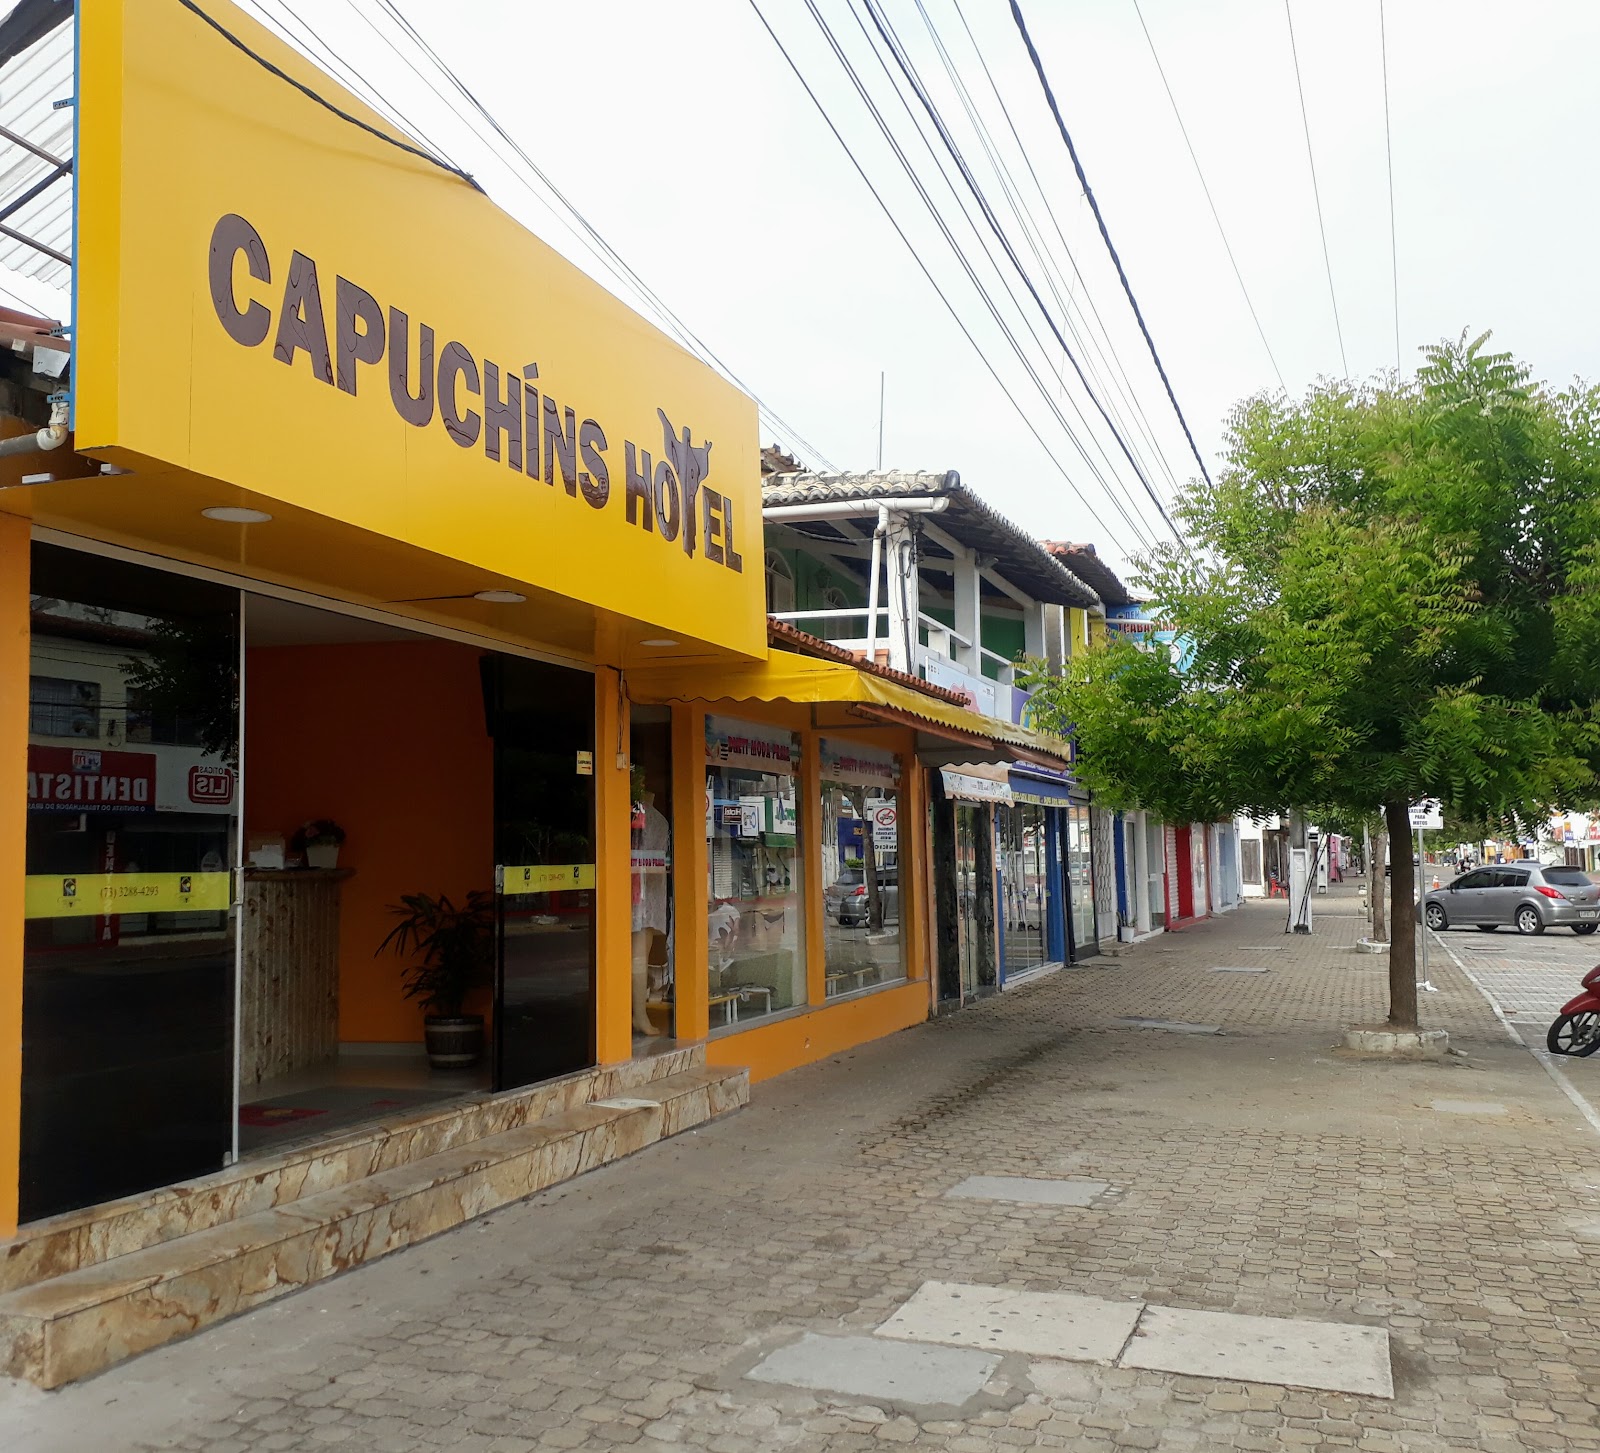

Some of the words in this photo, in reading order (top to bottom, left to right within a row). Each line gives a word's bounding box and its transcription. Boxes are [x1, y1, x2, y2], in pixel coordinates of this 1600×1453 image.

[208, 213, 610, 510] CAPUCHÍNS
[624, 407, 743, 573] HOTEL
[750, 740, 771, 759] MODA
[100, 886, 117, 899] (73)
[119, 885, 159, 897] 3288-4293
